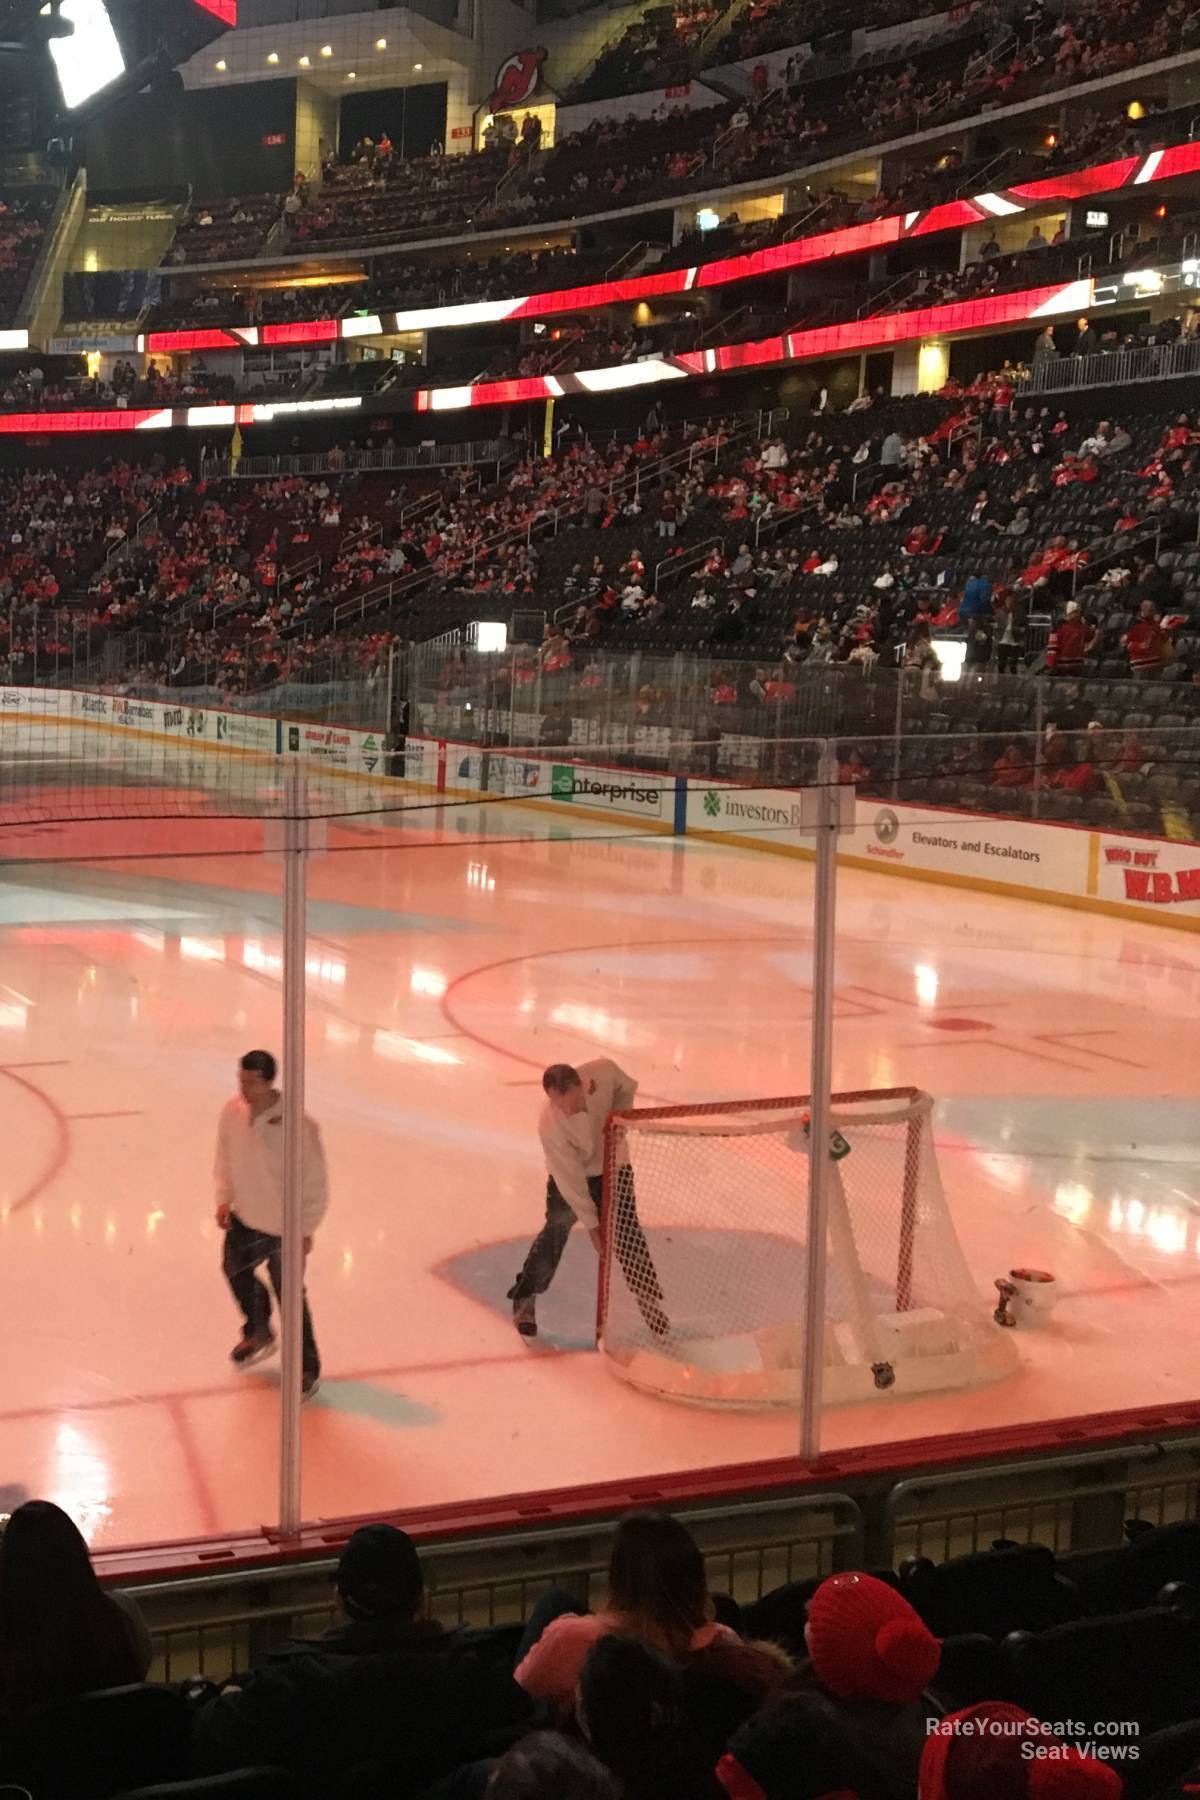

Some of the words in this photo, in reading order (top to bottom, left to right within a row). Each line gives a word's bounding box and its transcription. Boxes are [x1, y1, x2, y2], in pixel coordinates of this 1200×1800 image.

[557, 776, 660, 805] enterprise
[725, 795, 800, 826] investorsB
[912, 831, 958, 850] Elevators
[961, 841, 981, 853] and
[984, 842, 1040, 863] Escalators
[1105, 848, 1132, 863] WHO
[1134, 851, 1158, 867] BUT
